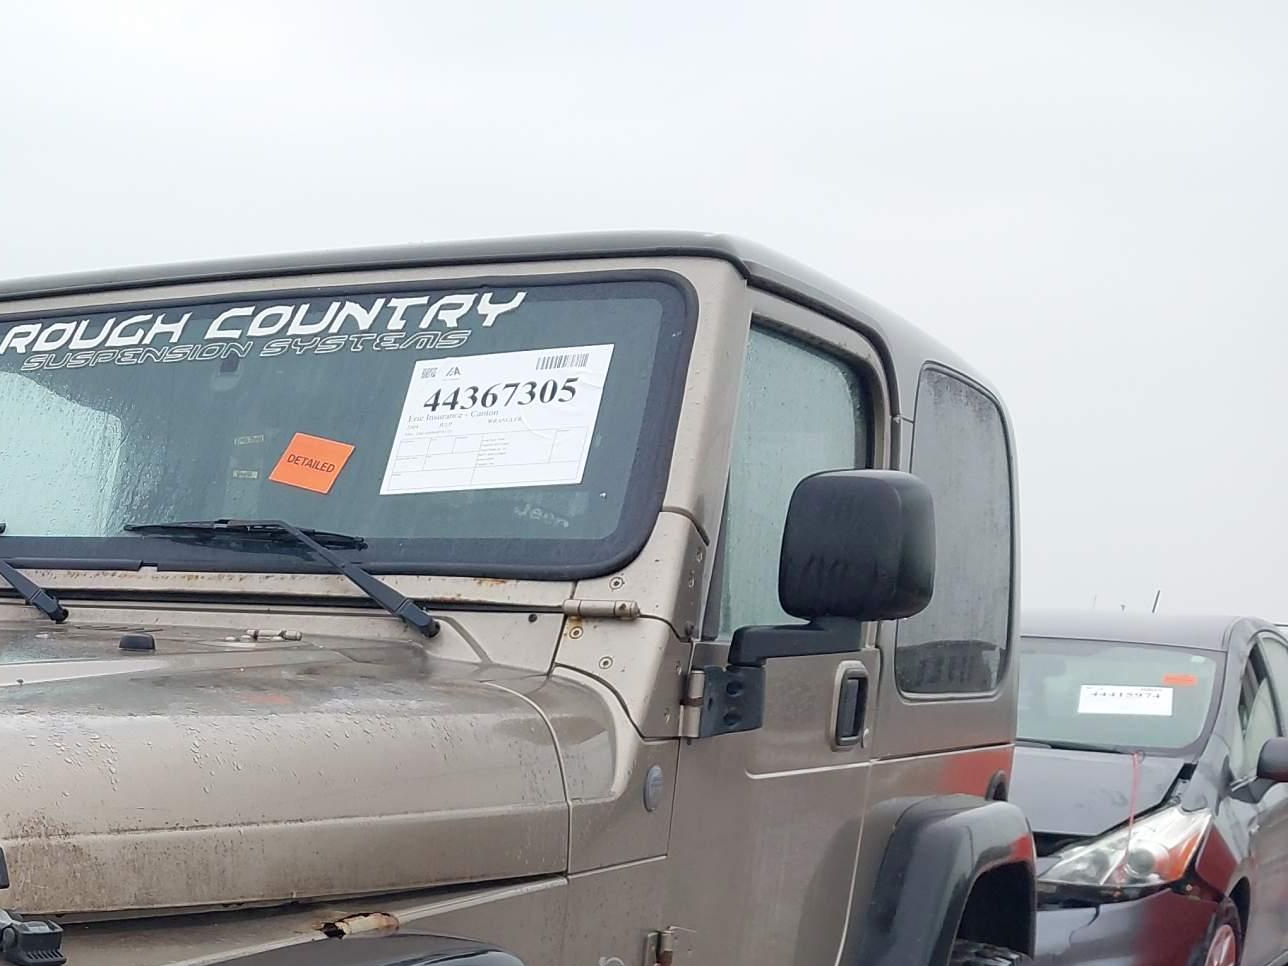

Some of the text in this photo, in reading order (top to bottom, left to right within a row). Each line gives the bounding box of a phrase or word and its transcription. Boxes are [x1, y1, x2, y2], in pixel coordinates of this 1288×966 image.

[204, 291, 527, 340] COUNTRY
[21, 329, 472, 372] SUSPENSION SYSTEMS
[423, 376, 580, 413] 44367305
[287, 453, 336, 474] DETAILED
